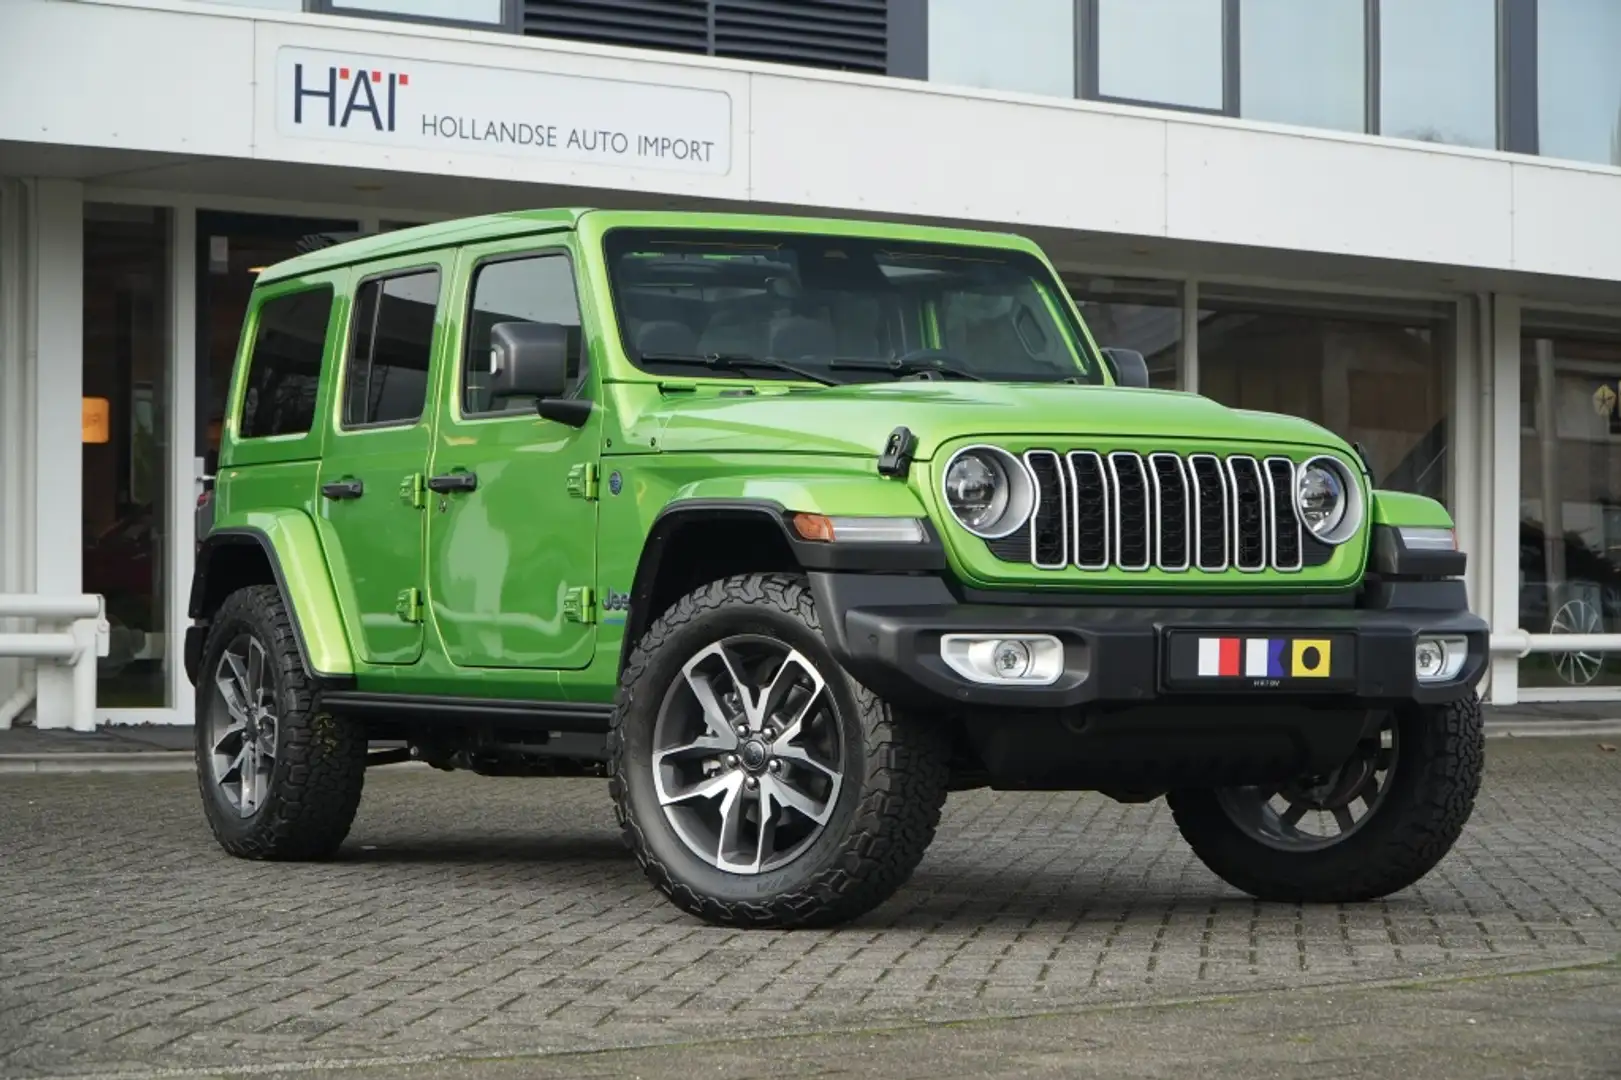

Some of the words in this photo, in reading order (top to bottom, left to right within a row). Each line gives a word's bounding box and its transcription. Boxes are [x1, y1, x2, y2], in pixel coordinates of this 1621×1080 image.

[422, 114, 557, 148] HOLLANDSE
[566, 128, 629, 154] AUTO
[637, 134, 715, 162] IMPORT
[602, 586, 631, 611] Jee
